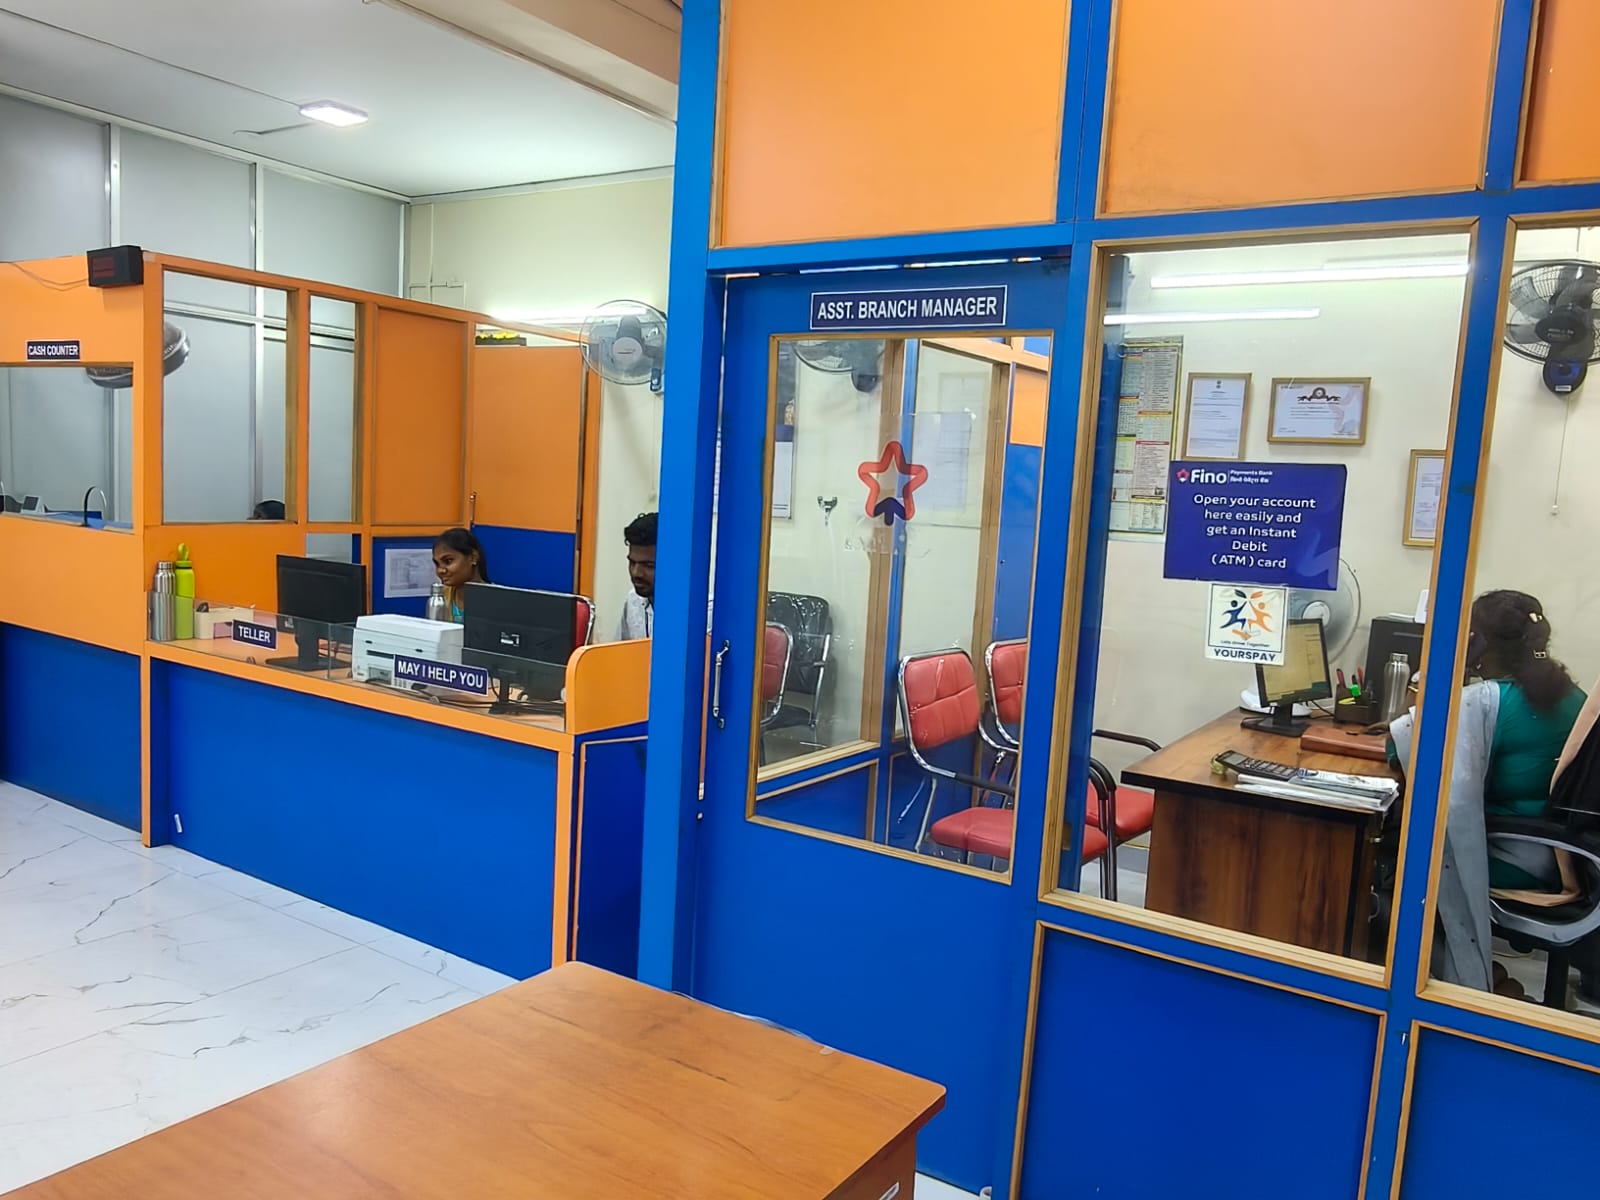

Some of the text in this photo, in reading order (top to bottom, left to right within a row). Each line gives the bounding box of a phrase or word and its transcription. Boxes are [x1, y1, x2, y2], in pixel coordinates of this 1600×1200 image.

[817, 296, 997, 320] ASST. BRANCH MANAGER
[28, 344, 78, 356] CASH COUNTER
[1190, 469, 1227, 484] Fino
[1194, 494, 1316, 508] Open your account
[1204, 509, 1302, 524] here easily and
[1206, 525, 1297, 538] get an Instant
[1232, 540, 1268, 552] Debit
[1257, 558, 1287, 569] card
[237, 624, 272, 644] TELLER
[1214, 648, 1276, 662] YOURSPAY
[397, 660, 484, 689] MAY I HELP YOU
